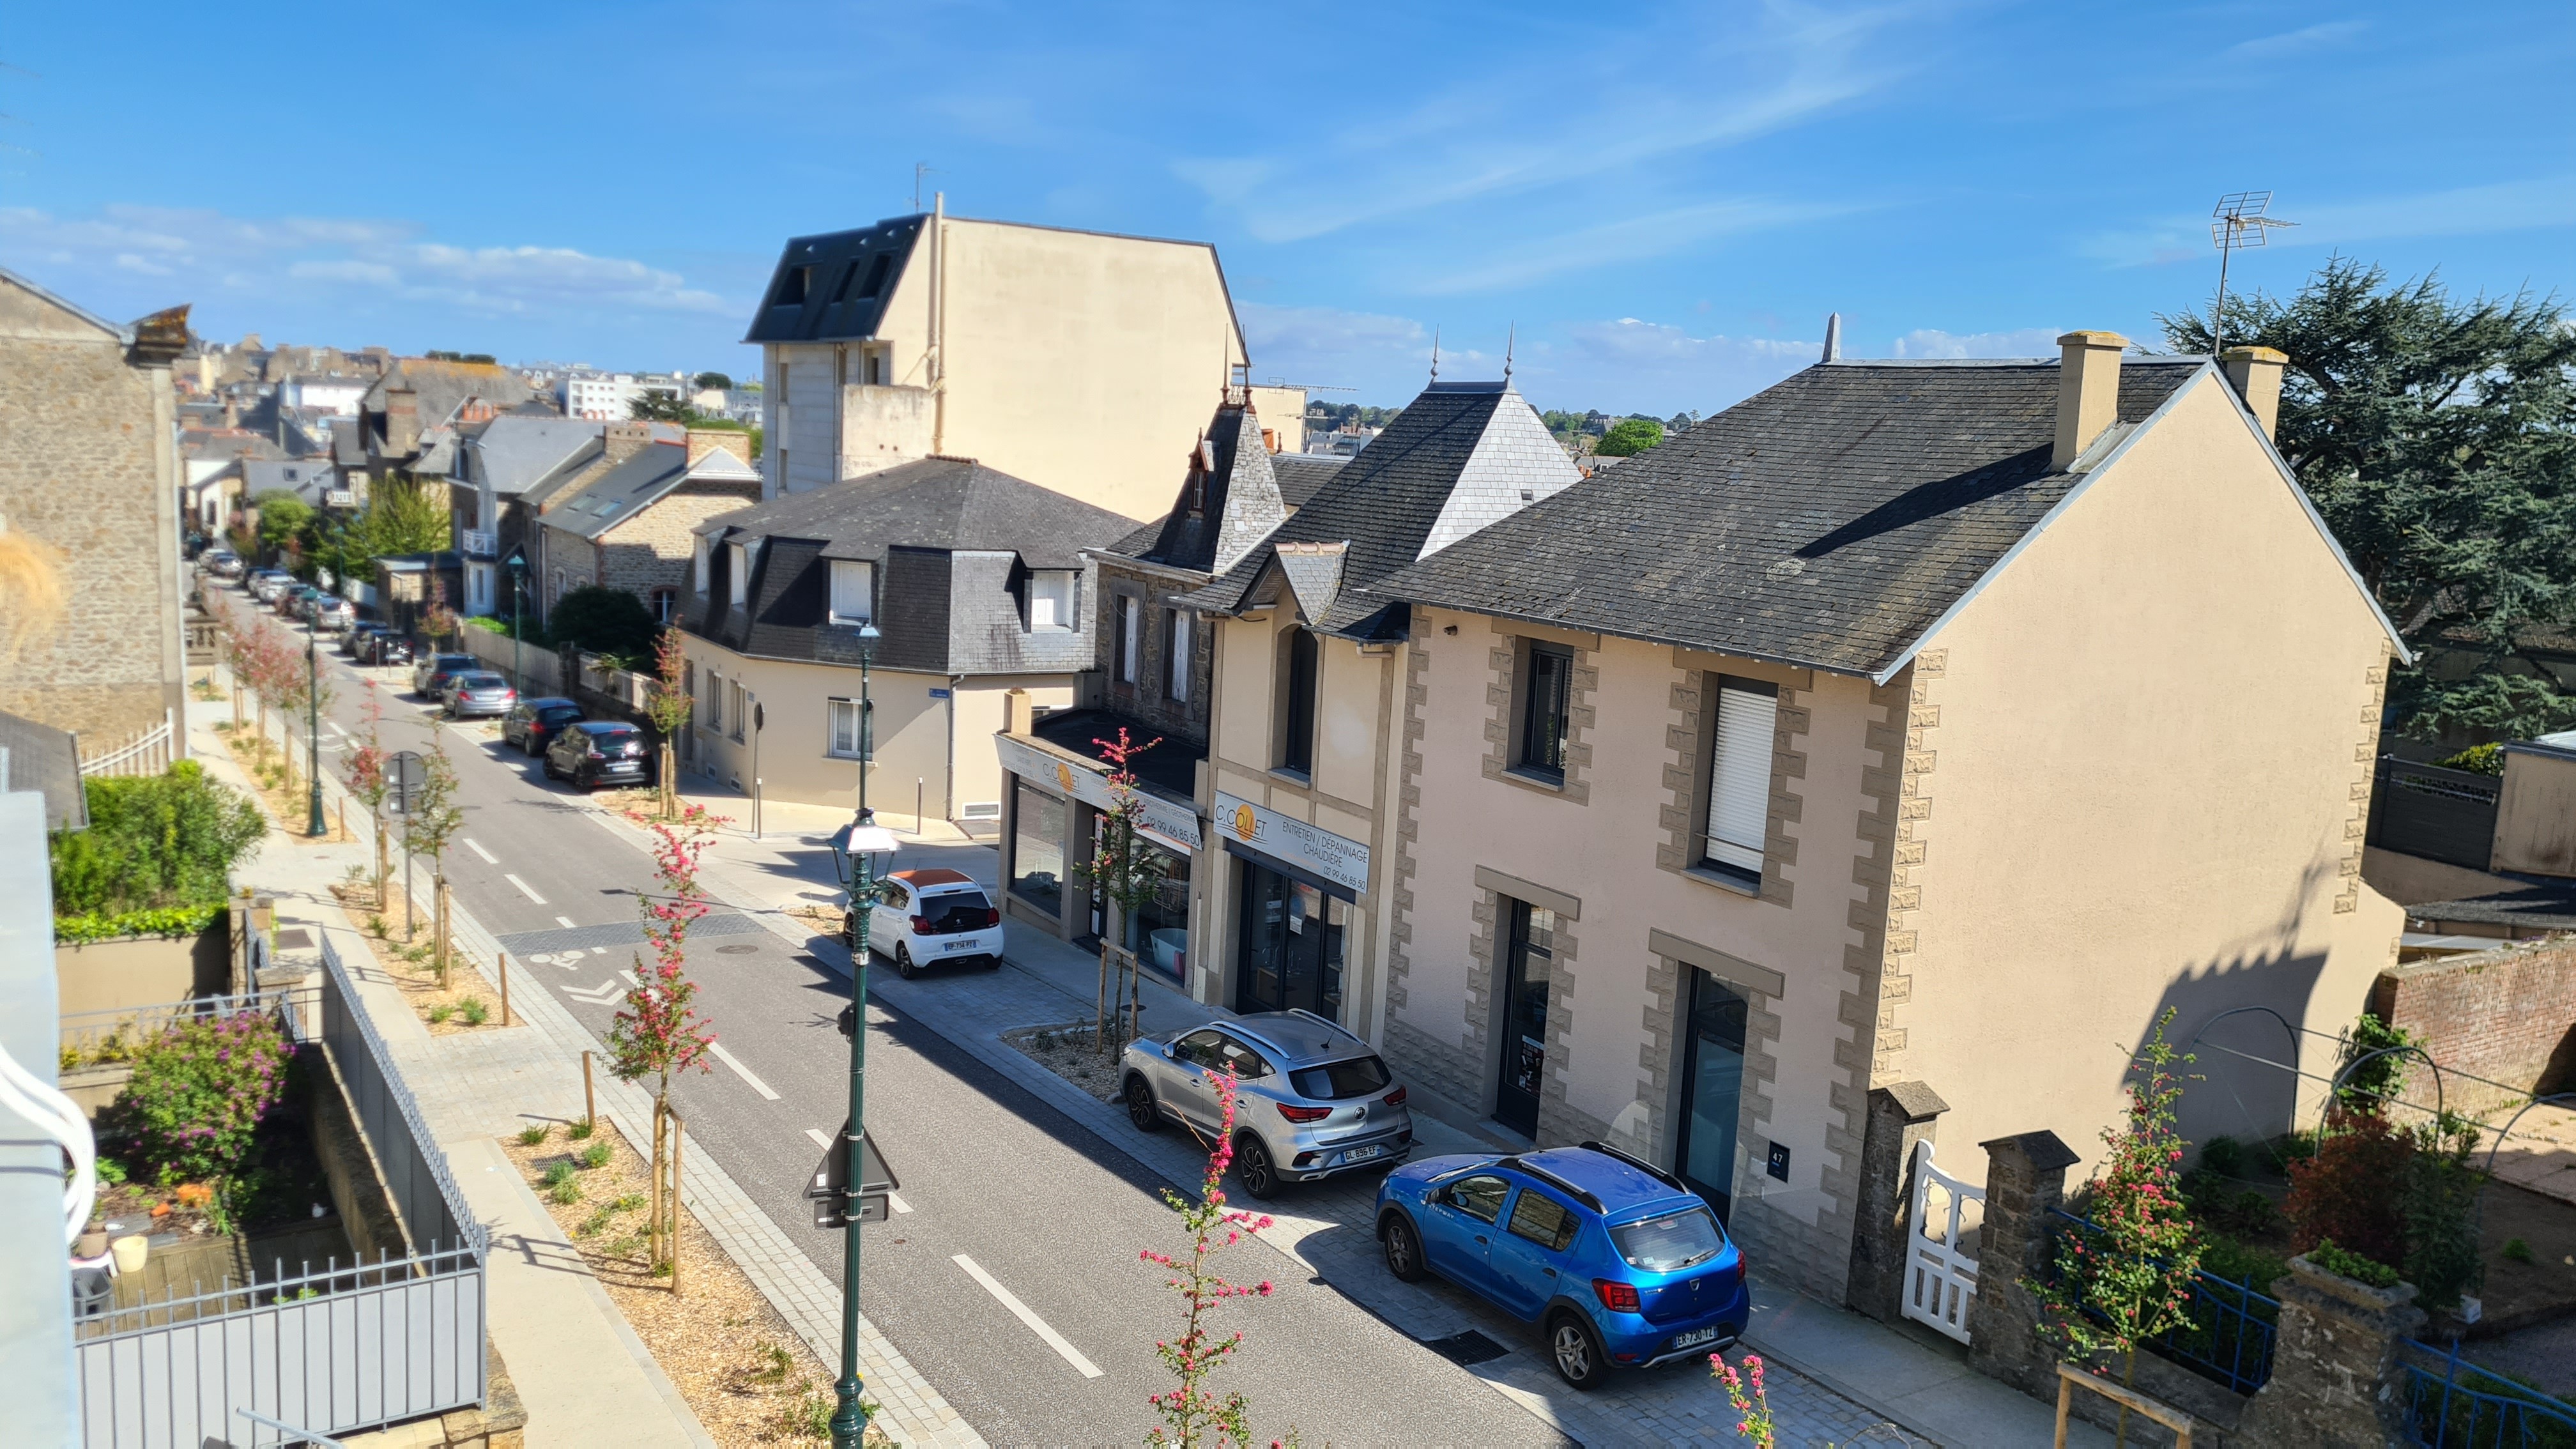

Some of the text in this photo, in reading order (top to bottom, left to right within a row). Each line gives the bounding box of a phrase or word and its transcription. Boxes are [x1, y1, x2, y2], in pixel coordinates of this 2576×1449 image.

[1158, 820, 1166, 831] 99
[1169, 825, 1177, 838] 46
[1179, 829, 1188, 842] 85
[1190, 833, 1200, 847] 50
[1216, 805, 1267, 837] C.COLLET
[1283, 822, 1315, 843] ENTRETIEN
[1322, 835, 1368, 863] DÉPANNAGE
[1303, 843, 1343, 868] CHAUDIÈRE
[1323, 866, 1365, 890] 02 99 46 85 50
[1773, 1153, 1782, 1163] 47
